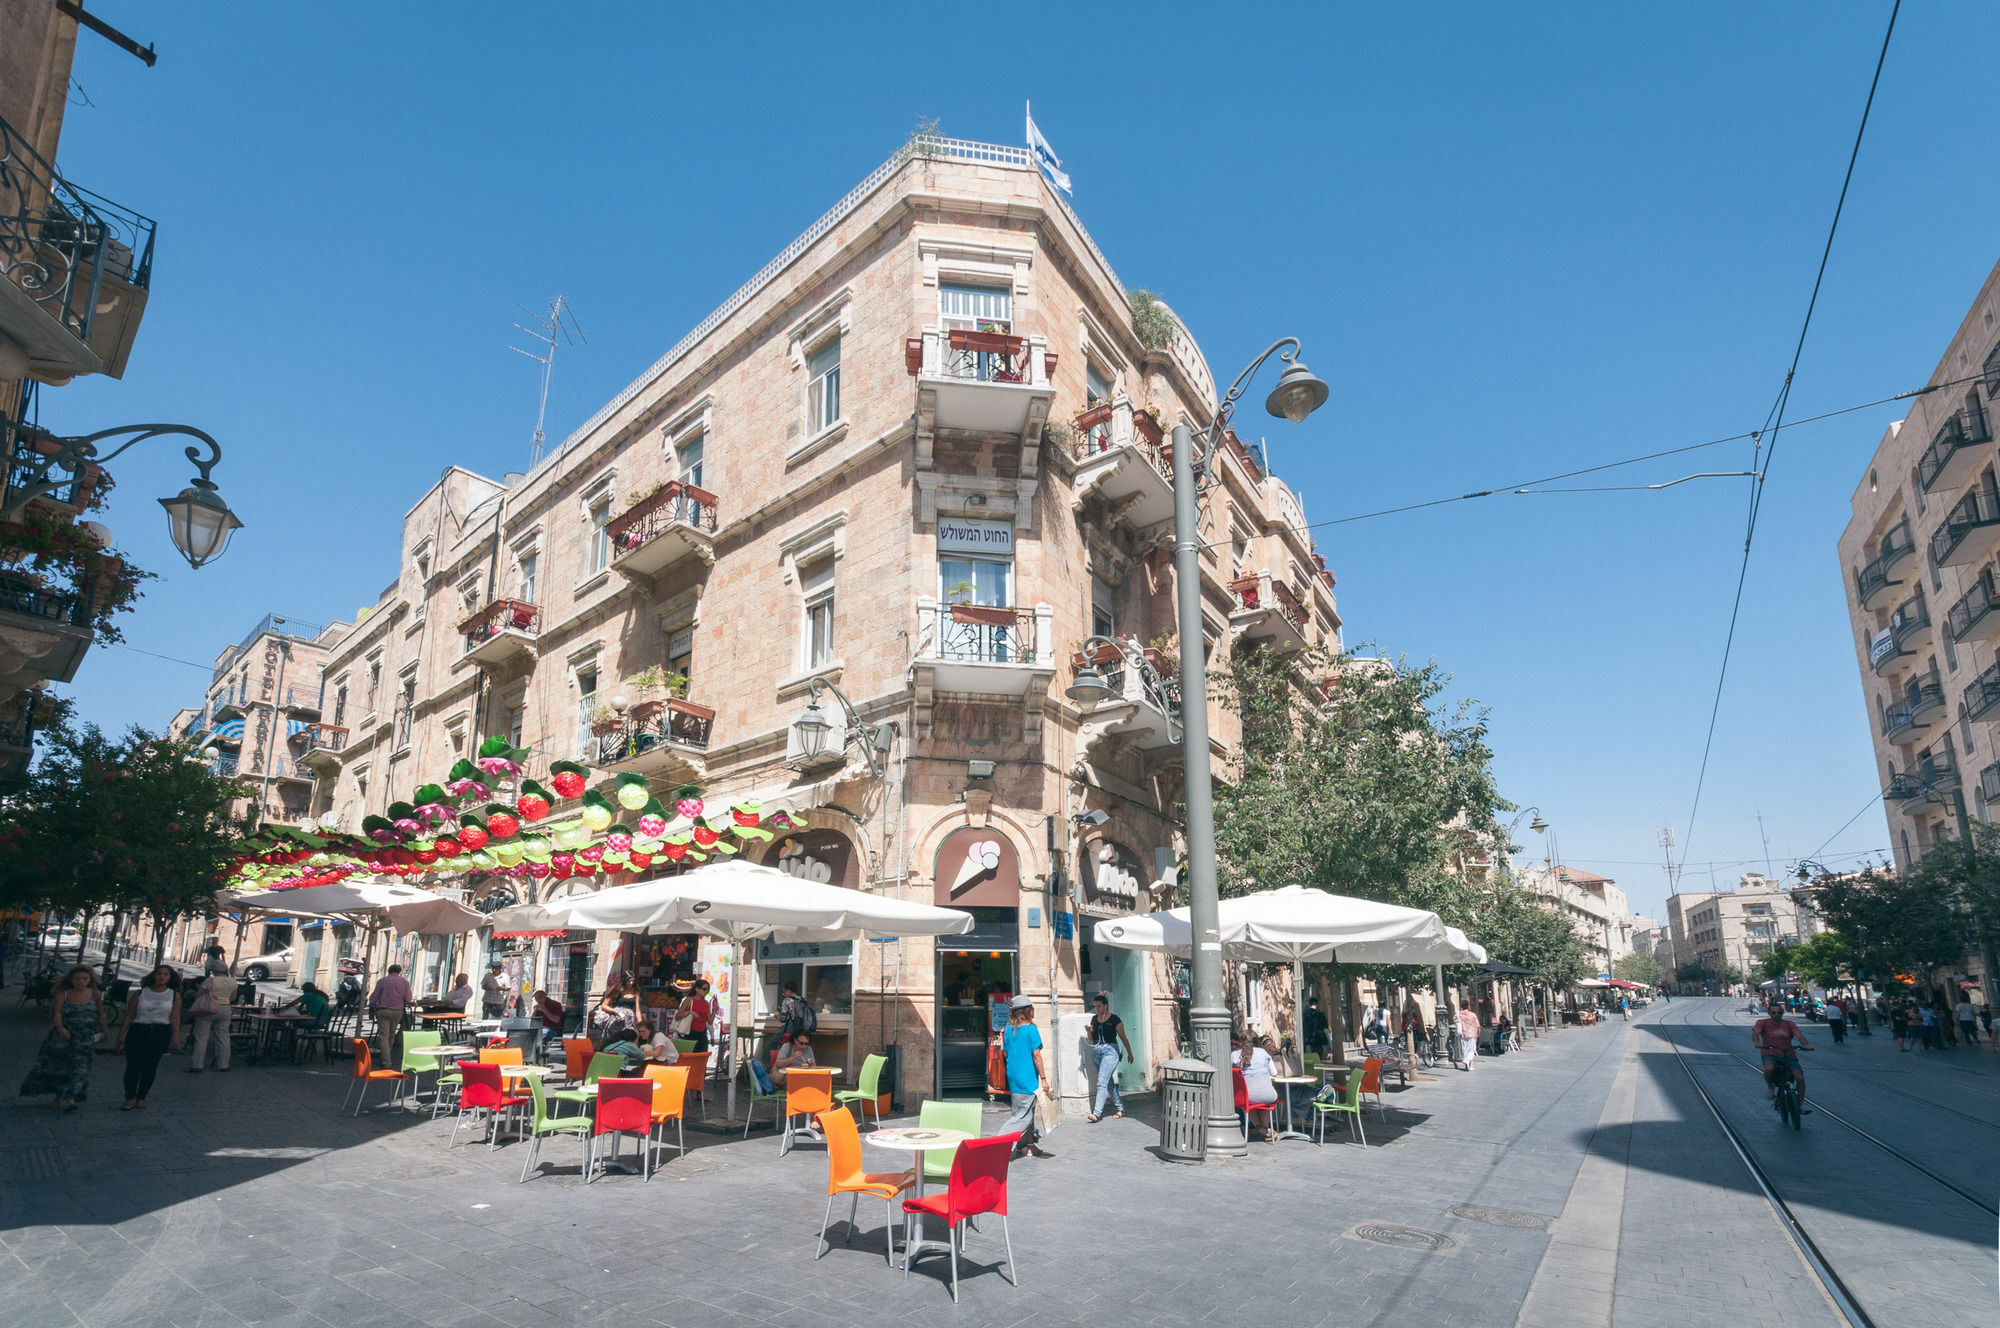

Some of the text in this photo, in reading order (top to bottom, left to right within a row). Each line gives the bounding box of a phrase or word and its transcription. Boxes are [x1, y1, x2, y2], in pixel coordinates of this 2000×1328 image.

[940, 523, 1009, 544] החוט המשולש
[262, 639, 278, 702] HOTEL
[1097, 863, 1139, 897] Aldo
